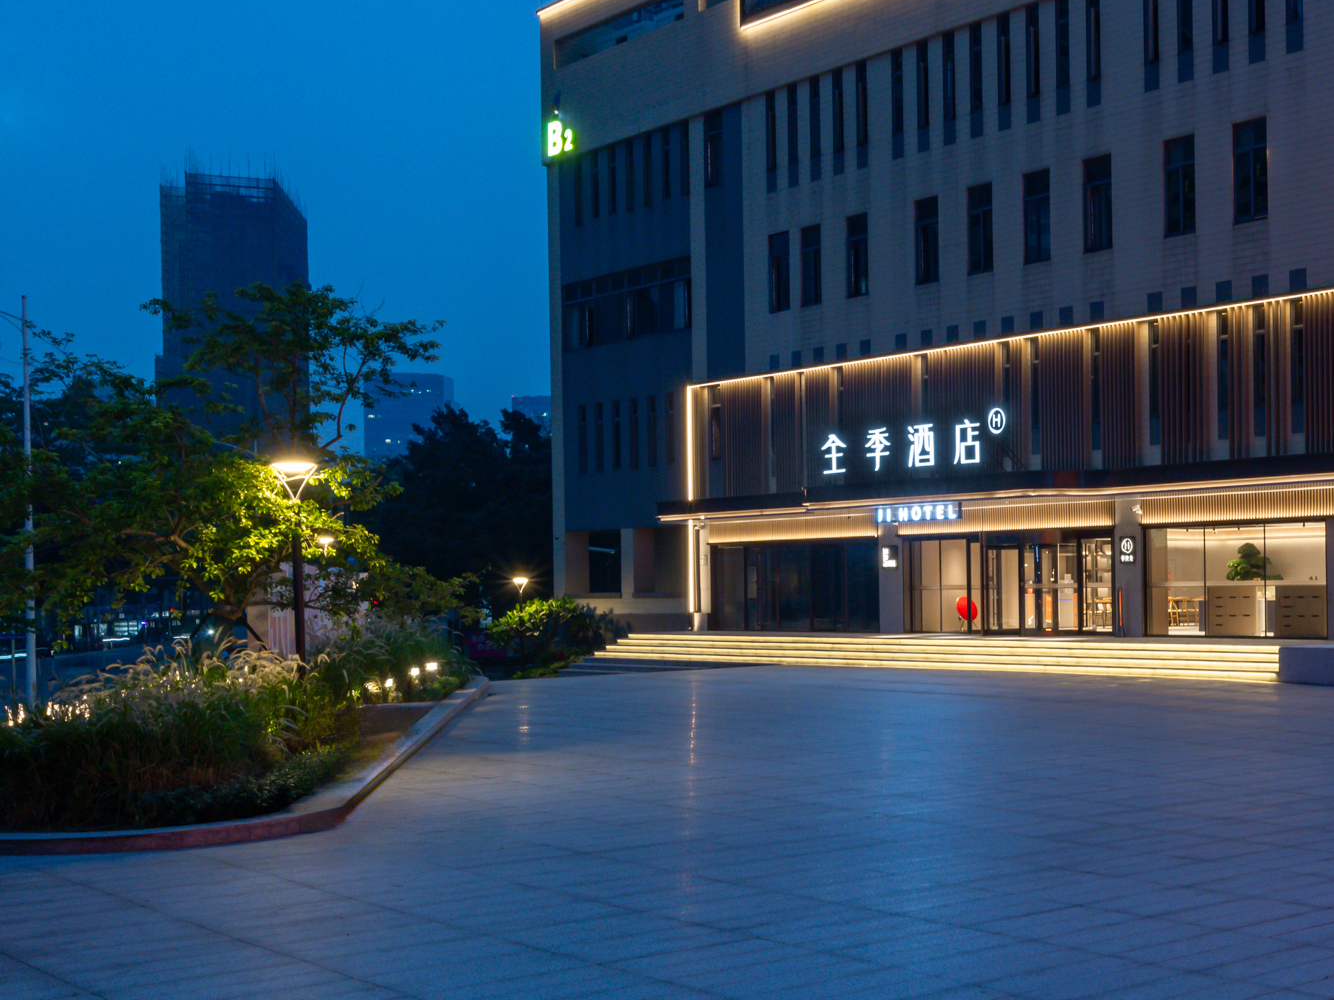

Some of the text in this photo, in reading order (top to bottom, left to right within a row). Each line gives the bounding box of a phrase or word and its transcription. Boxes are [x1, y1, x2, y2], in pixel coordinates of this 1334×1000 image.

[548, 121, 573, 156] B2
[820, 418, 980, 475] 全季酒店
[898, 504, 958, 521] HOTEL
